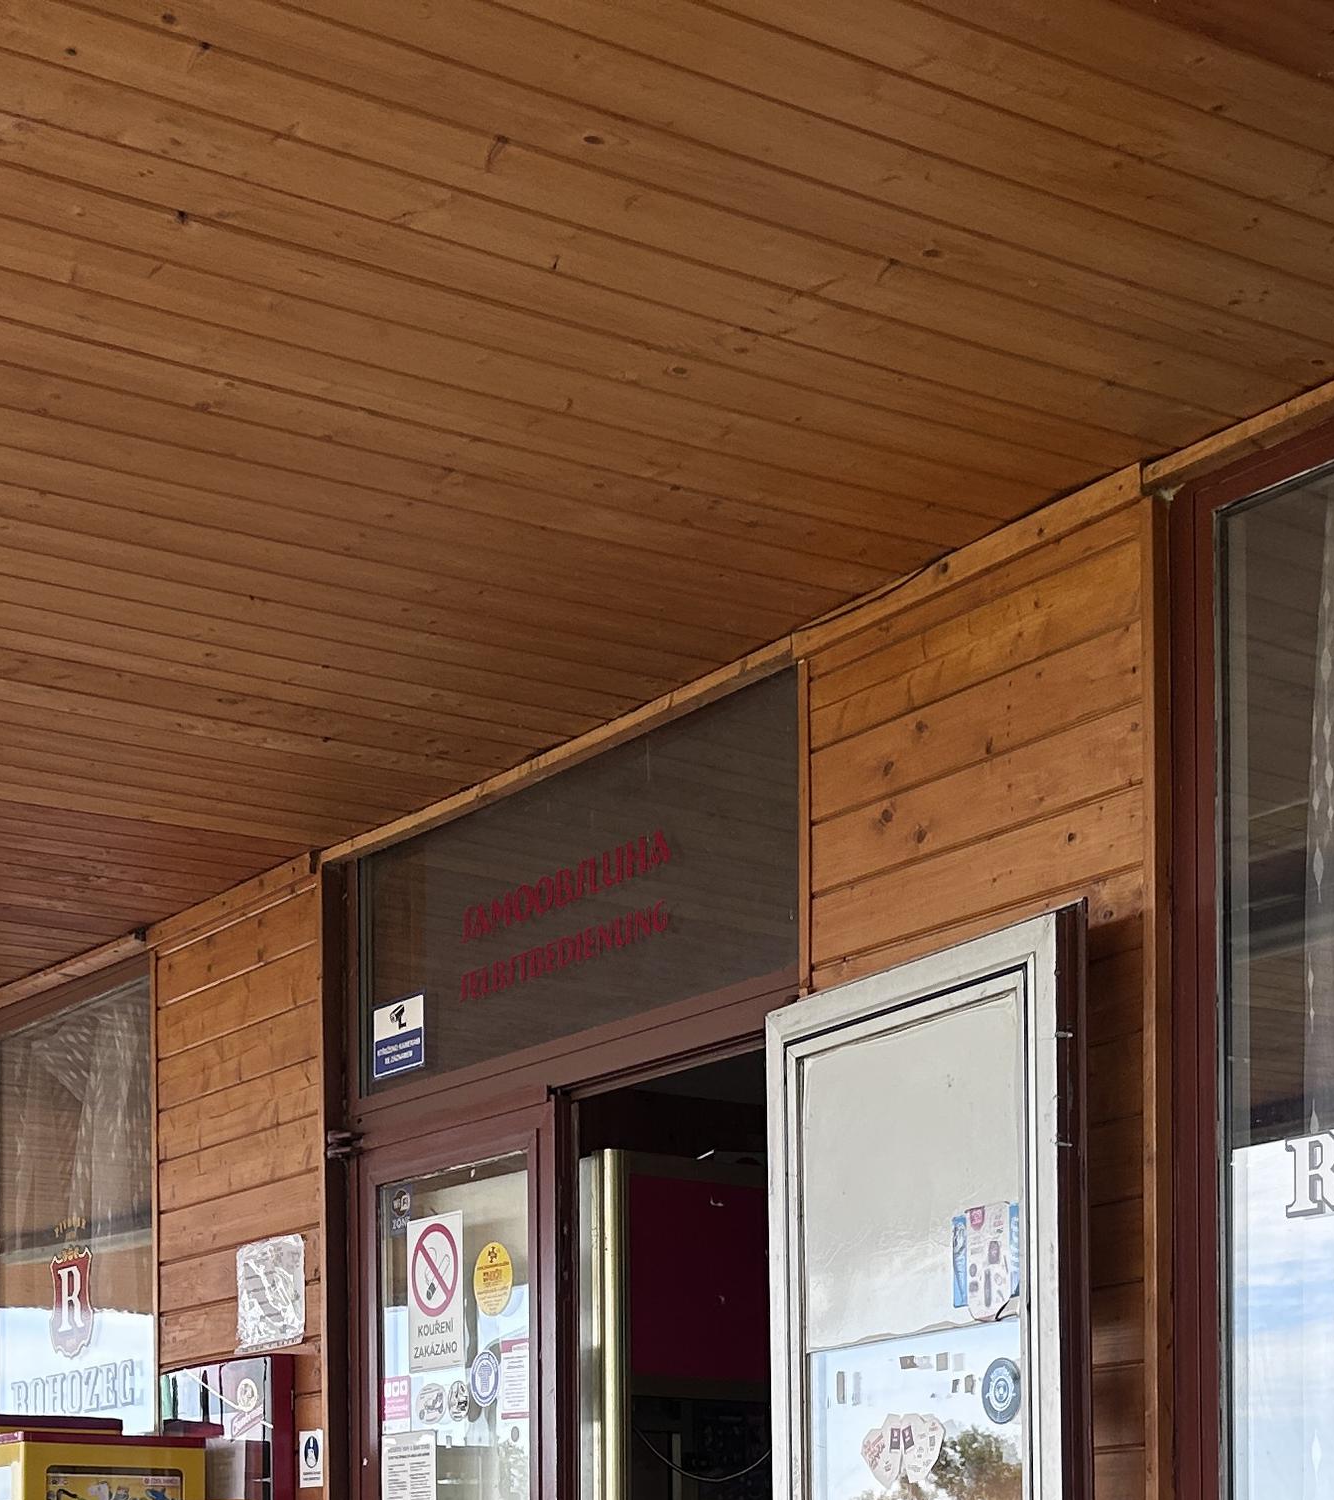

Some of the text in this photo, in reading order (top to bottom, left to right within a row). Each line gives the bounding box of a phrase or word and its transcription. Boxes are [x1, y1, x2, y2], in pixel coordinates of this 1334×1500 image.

[57, 1265, 85, 1332] R
[417, 1316, 455, 1338] KOUŘENÍ
[413, 1340, 459, 1359] ZAKÁZÁNO
[11, 1359, 136, 1415] ROHOZEC
